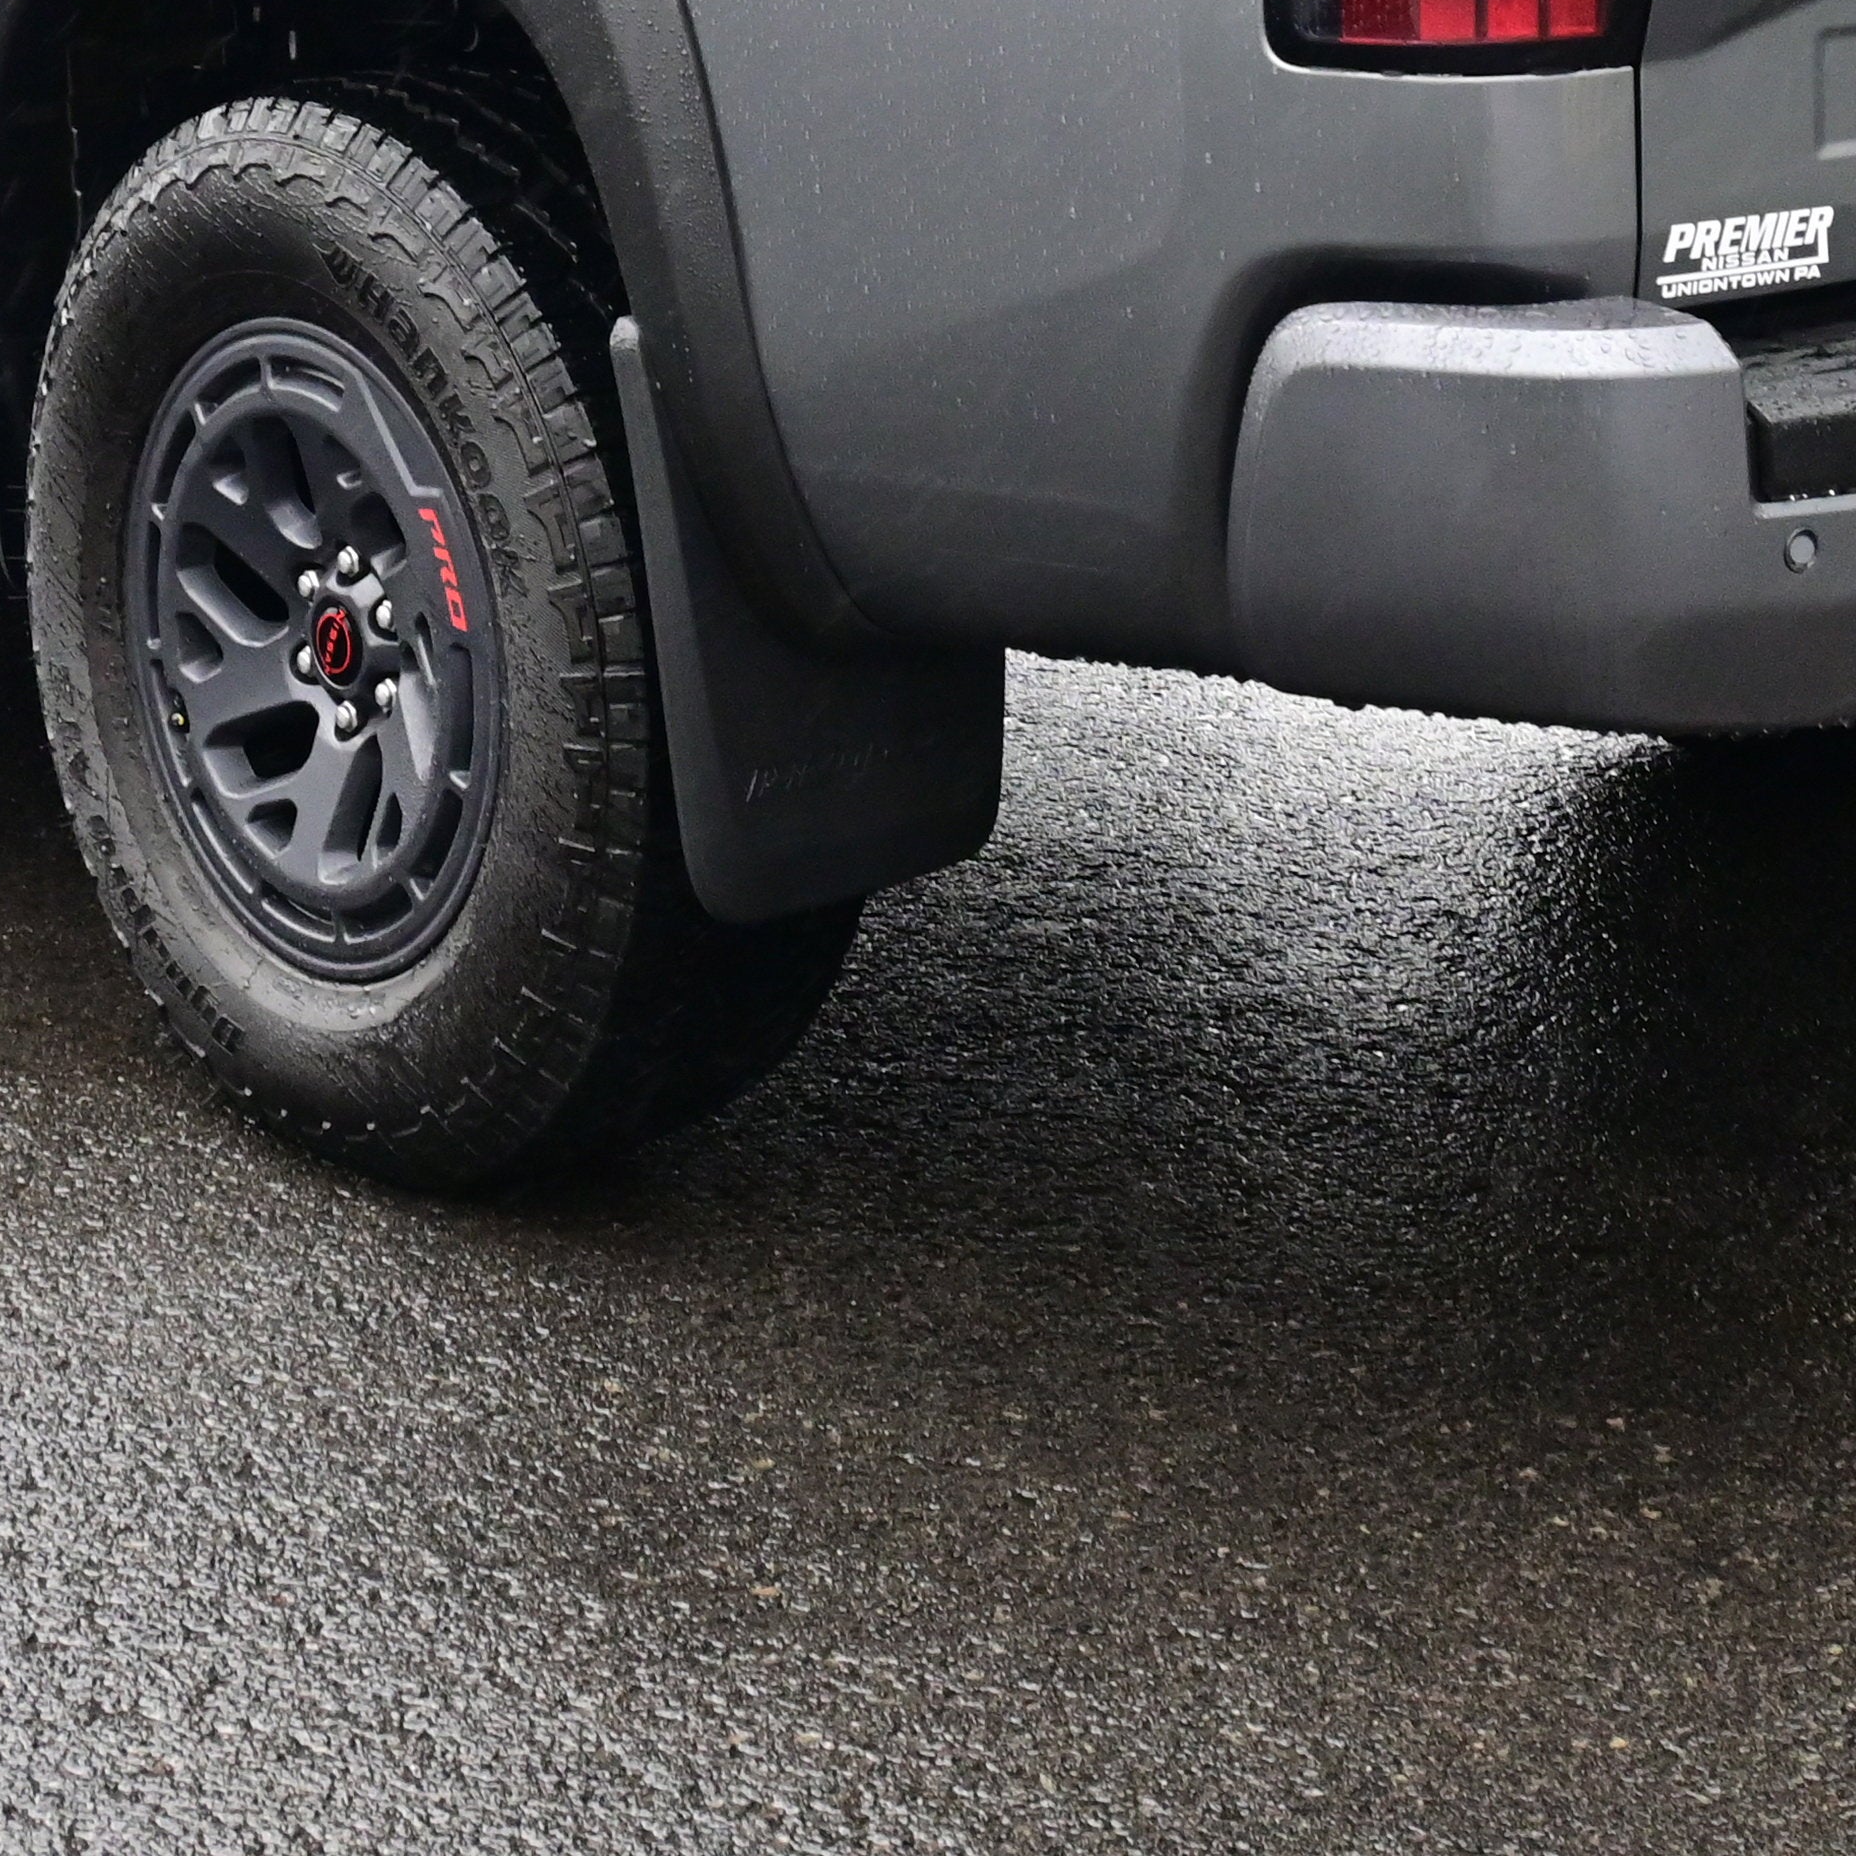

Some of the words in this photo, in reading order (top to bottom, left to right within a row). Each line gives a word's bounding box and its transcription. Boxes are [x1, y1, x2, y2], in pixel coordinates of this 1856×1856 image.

[1662, 205, 1834, 263] PREMIER
[1661, 267, 1790, 299] UNIONTOWN
[1794, 264, 1822, 282] PA
[1701, 247, 1790, 272] NISSAN
[417, 508, 469, 633] PRO
